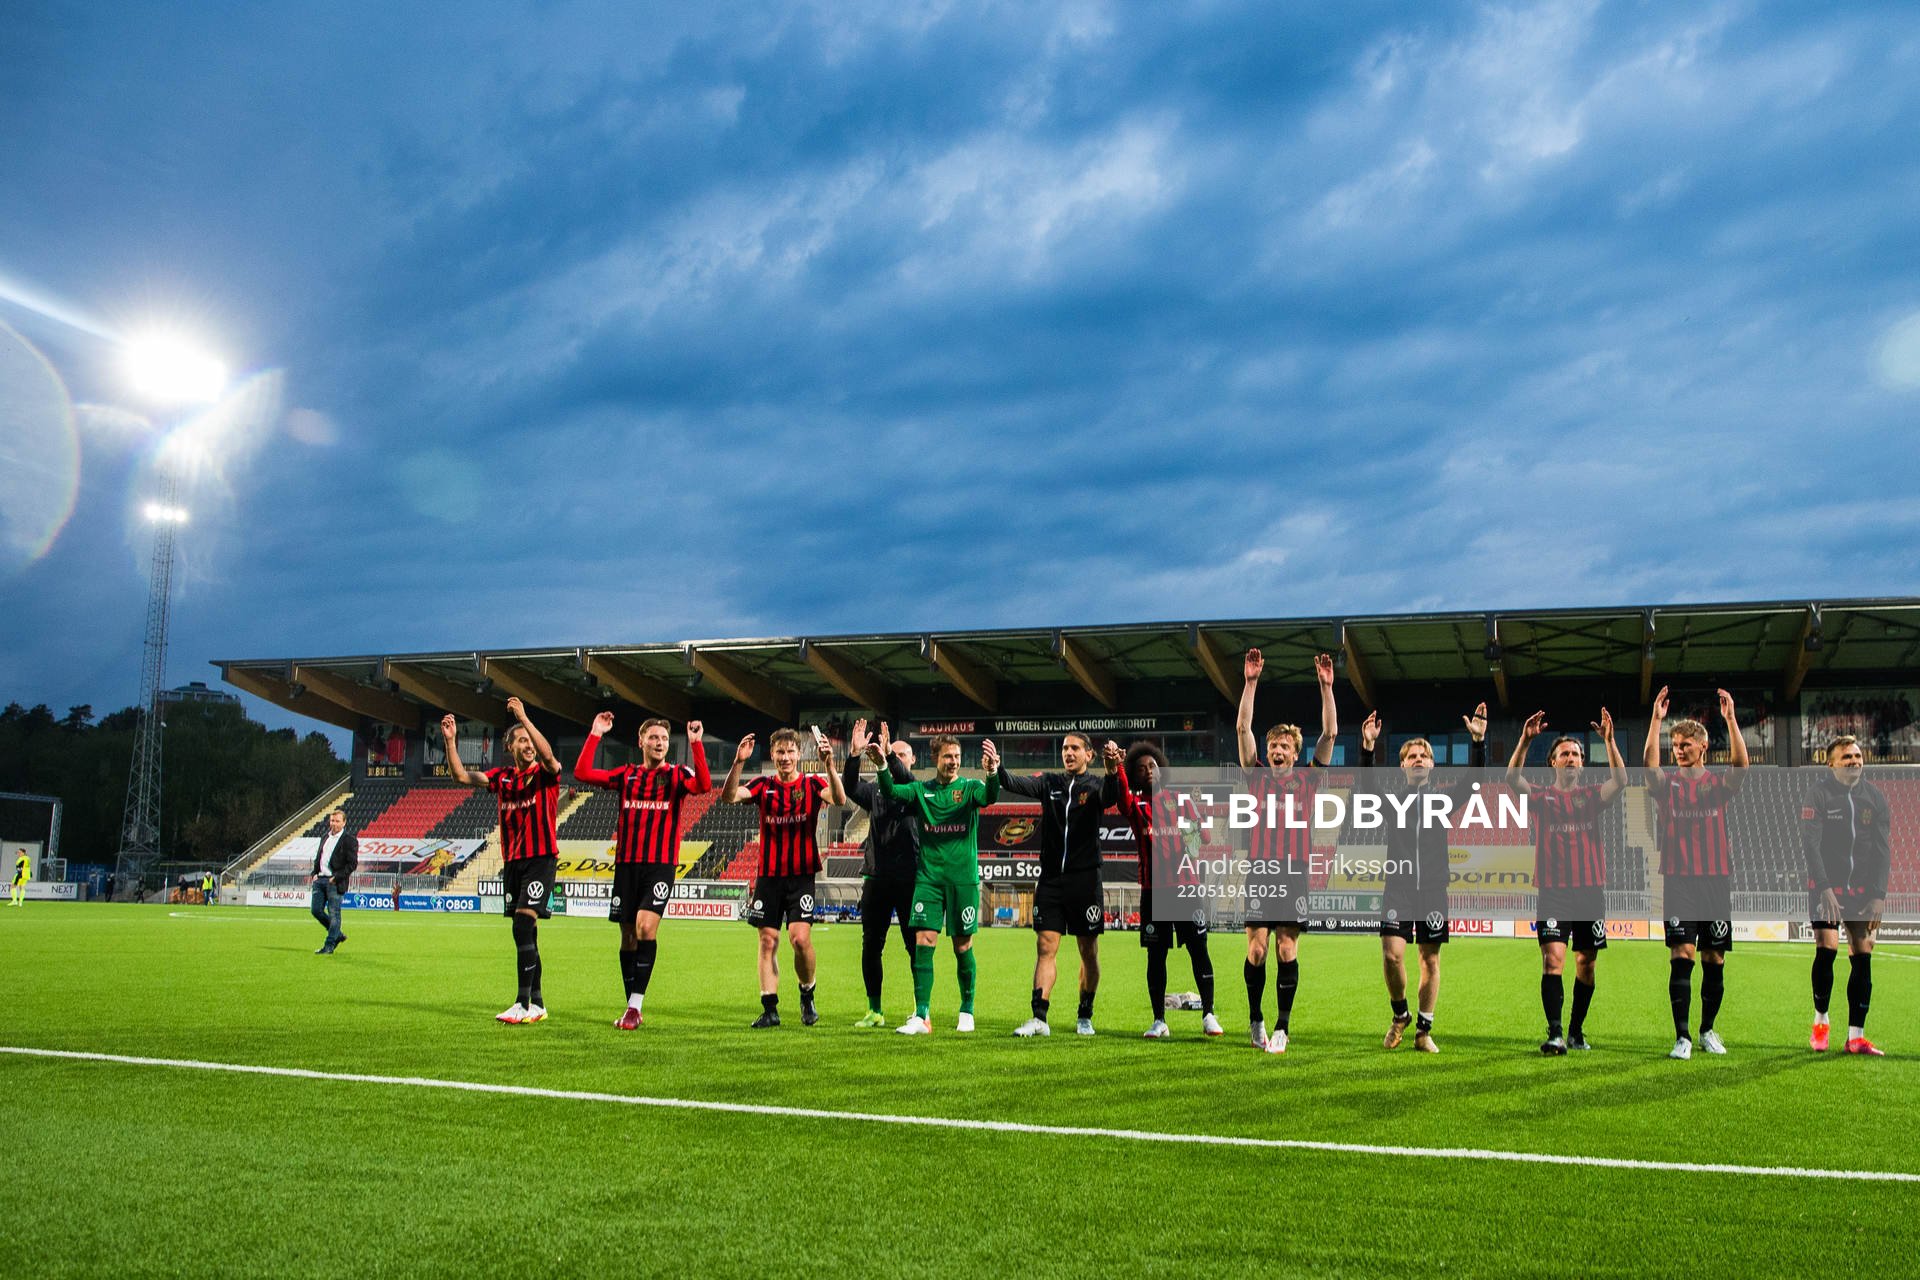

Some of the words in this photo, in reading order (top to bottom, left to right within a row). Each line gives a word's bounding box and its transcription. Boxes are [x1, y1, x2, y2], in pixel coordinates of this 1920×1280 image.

[921, 722, 975, 733] BAUHAUS
[995, 722, 1004, 731] VI
[1006, 721, 1040, 731] BYGGER
[1042, 720, 1077, 731] SVENSK
[1079, 718, 1157, 730] UNGDOMSIDROTT
[624, 800, 670, 810] BAUHAUS
[358, 841, 415, 858] Stop
[51, 885, 74, 894] NEXT
[565, 883, 614, 897] UNIBET
[274, 892, 294, 900] DEMO
[369, 897, 394, 908] OBOS
[446, 899, 474, 910] OBOS
[1309, 895, 1356, 910] ERETTAN
[668, 903, 731, 916] BAUHAUS
[1340, 920, 1381, 928] Stockholm
